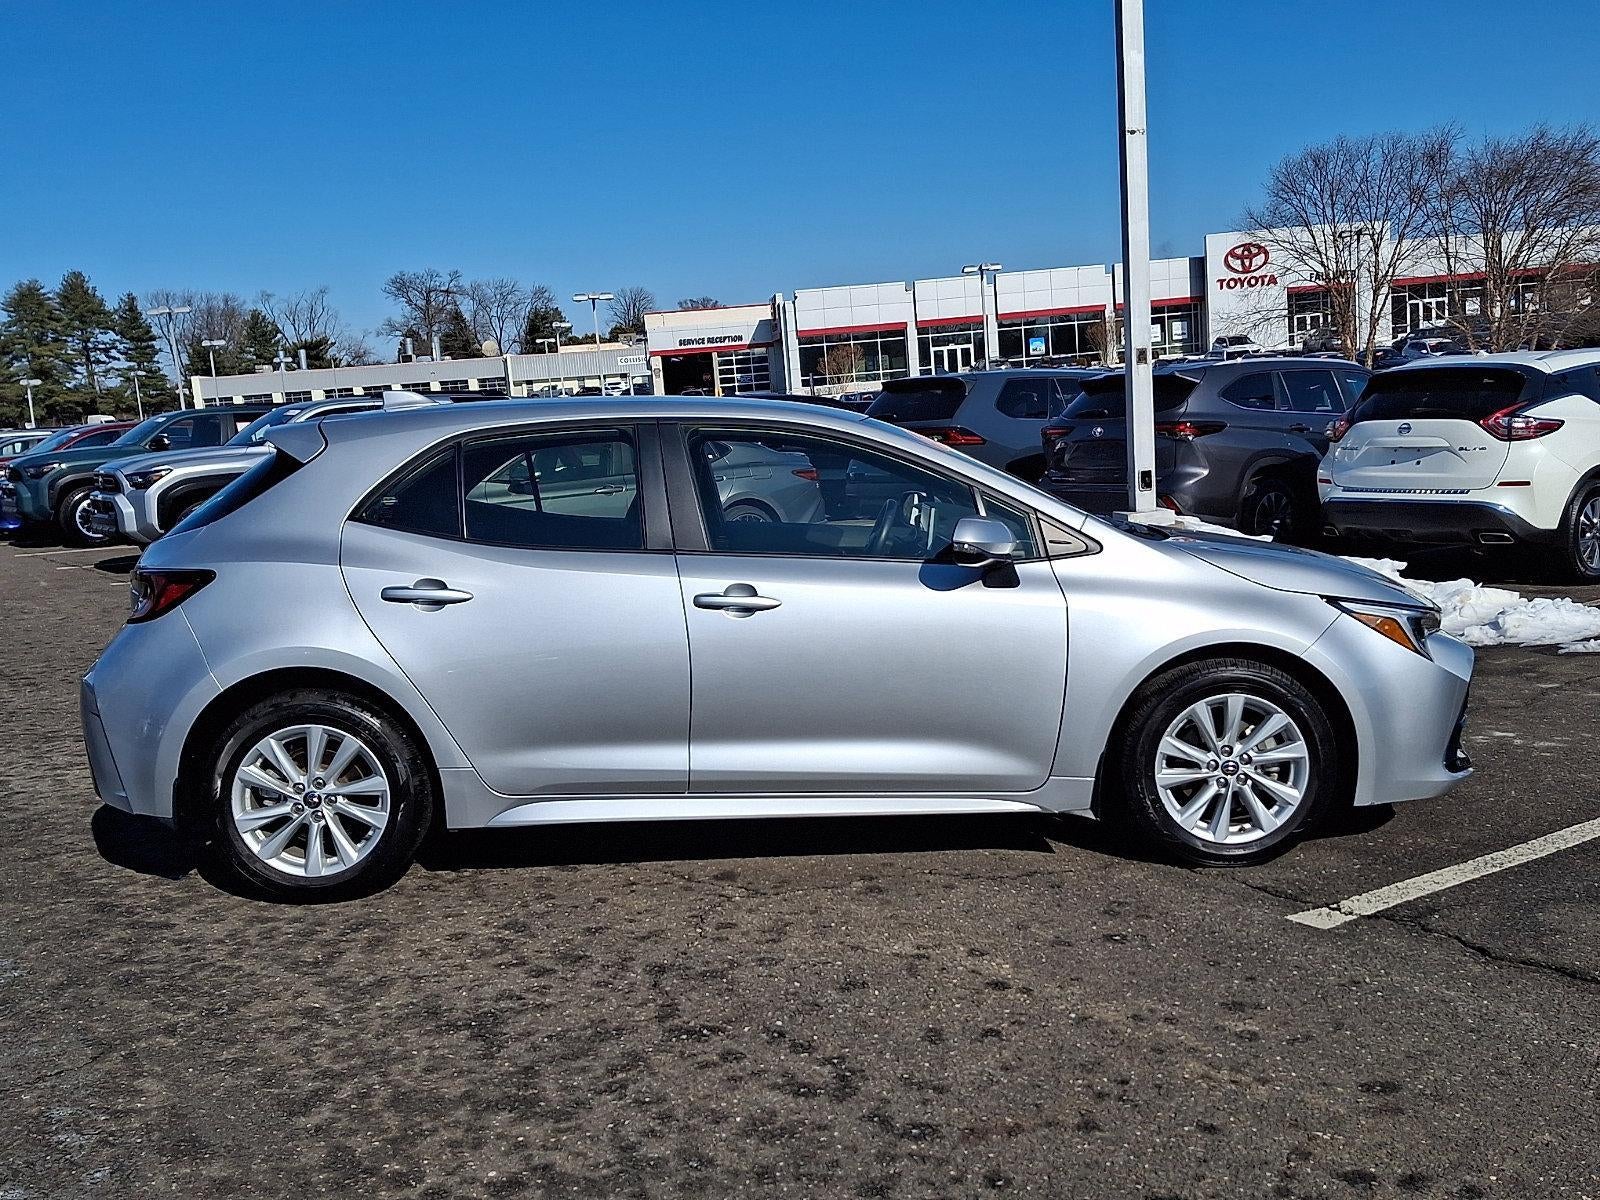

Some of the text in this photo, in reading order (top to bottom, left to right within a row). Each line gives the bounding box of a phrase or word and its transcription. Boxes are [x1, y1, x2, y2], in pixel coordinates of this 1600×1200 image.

[1216, 274, 1278, 290] TOYOTA
[678, 334, 743, 347] SERVICE RECEPTION
